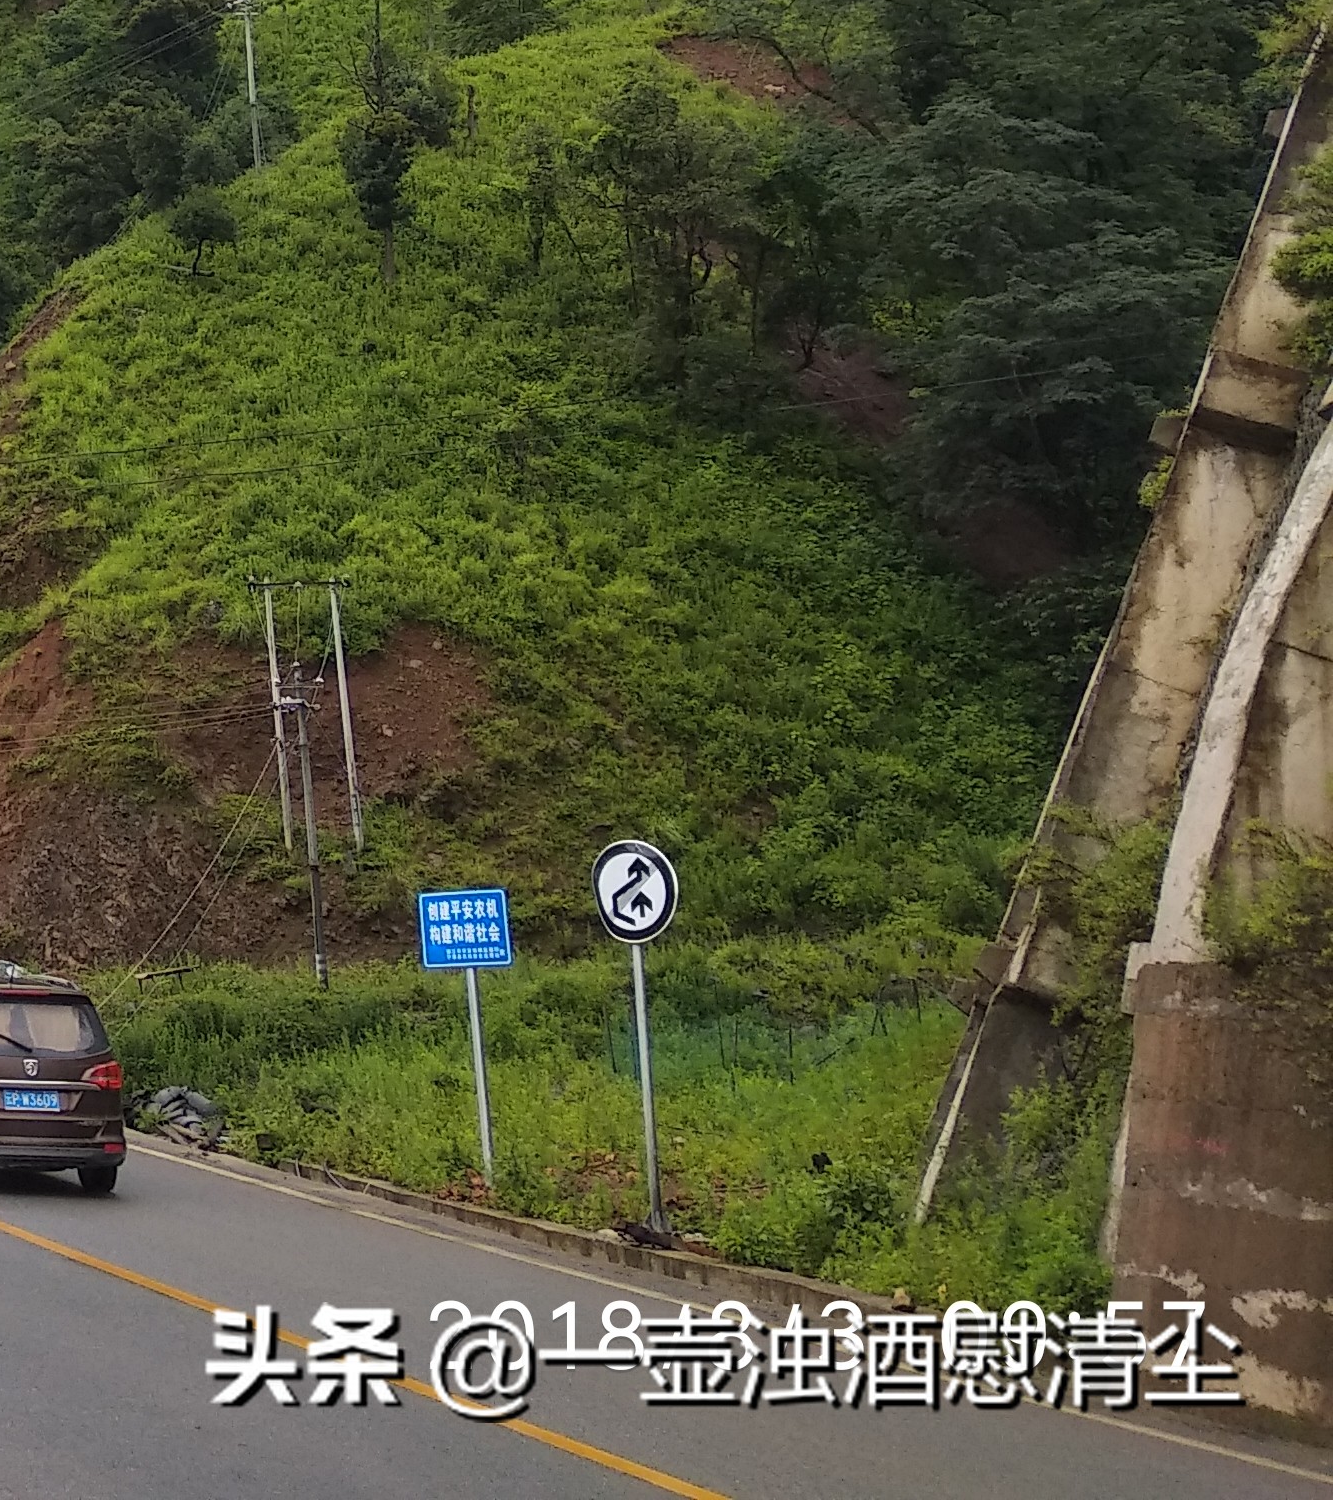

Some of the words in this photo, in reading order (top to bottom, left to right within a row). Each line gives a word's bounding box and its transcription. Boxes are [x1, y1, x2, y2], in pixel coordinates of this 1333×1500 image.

[428, 897, 500, 921] 创建平安农机
[429, 921, 501, 945] 构建和谐社会
